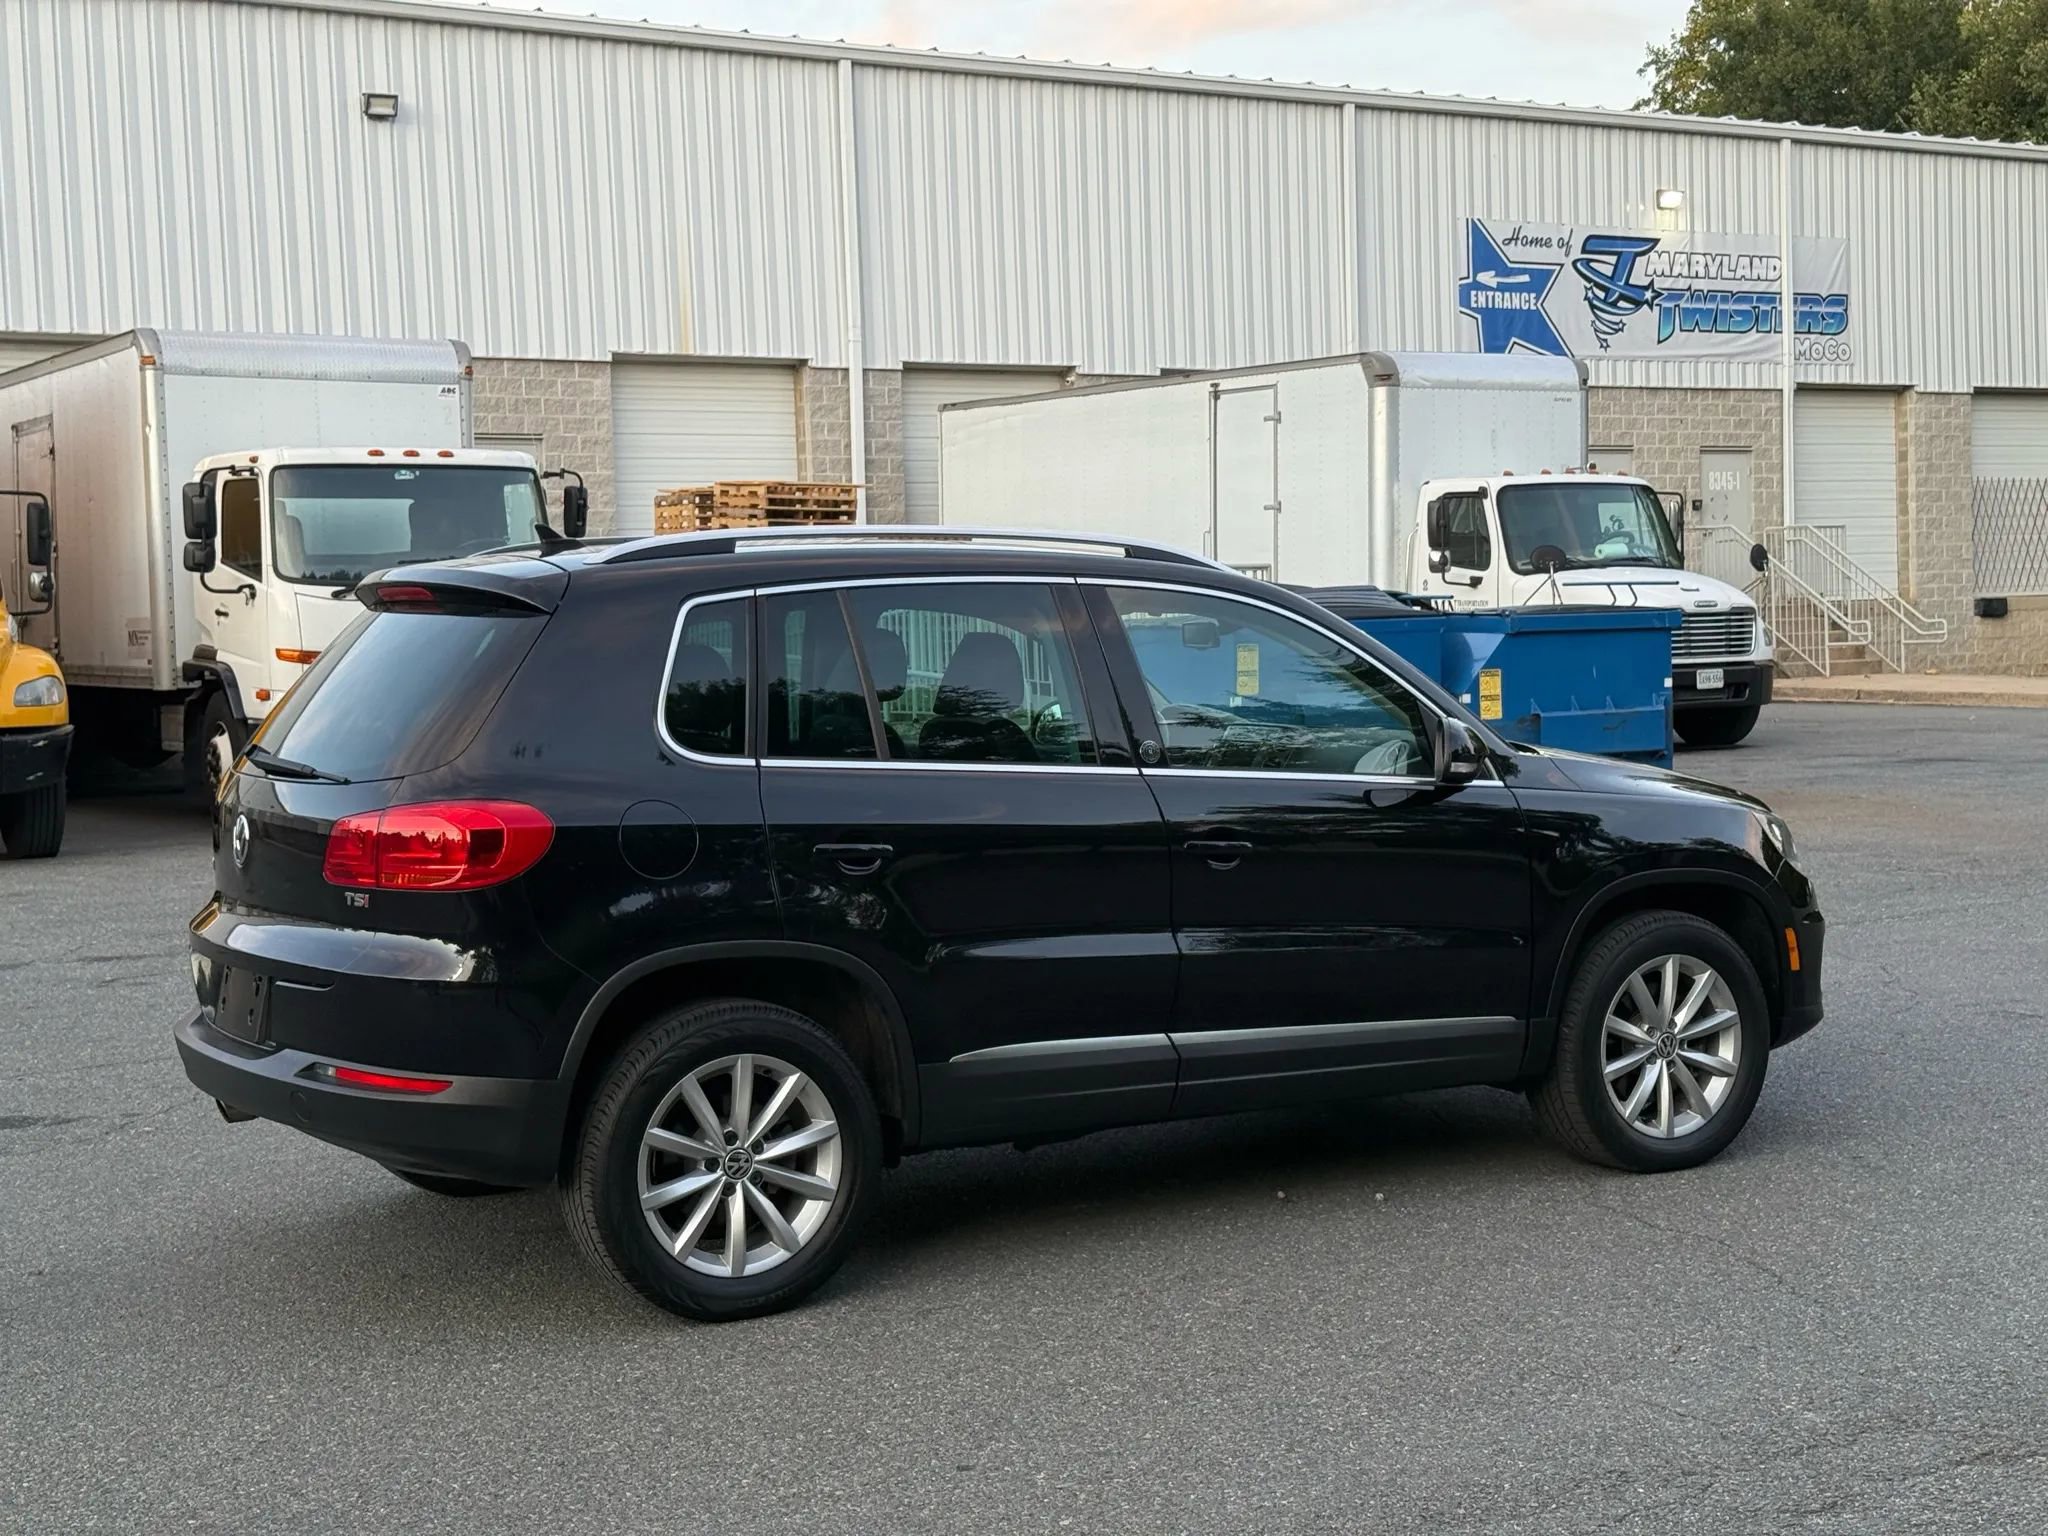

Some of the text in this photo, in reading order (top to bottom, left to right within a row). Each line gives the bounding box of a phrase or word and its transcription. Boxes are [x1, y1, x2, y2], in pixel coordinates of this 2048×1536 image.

[1501, 225, 1573, 257] Home of
[1645, 251, 1782, 281] MARYLAND
[1470, 290, 1537, 310] ENTRANCE
[1793, 337, 1851, 361] MoCo
[344, 891, 369, 908] TSI
